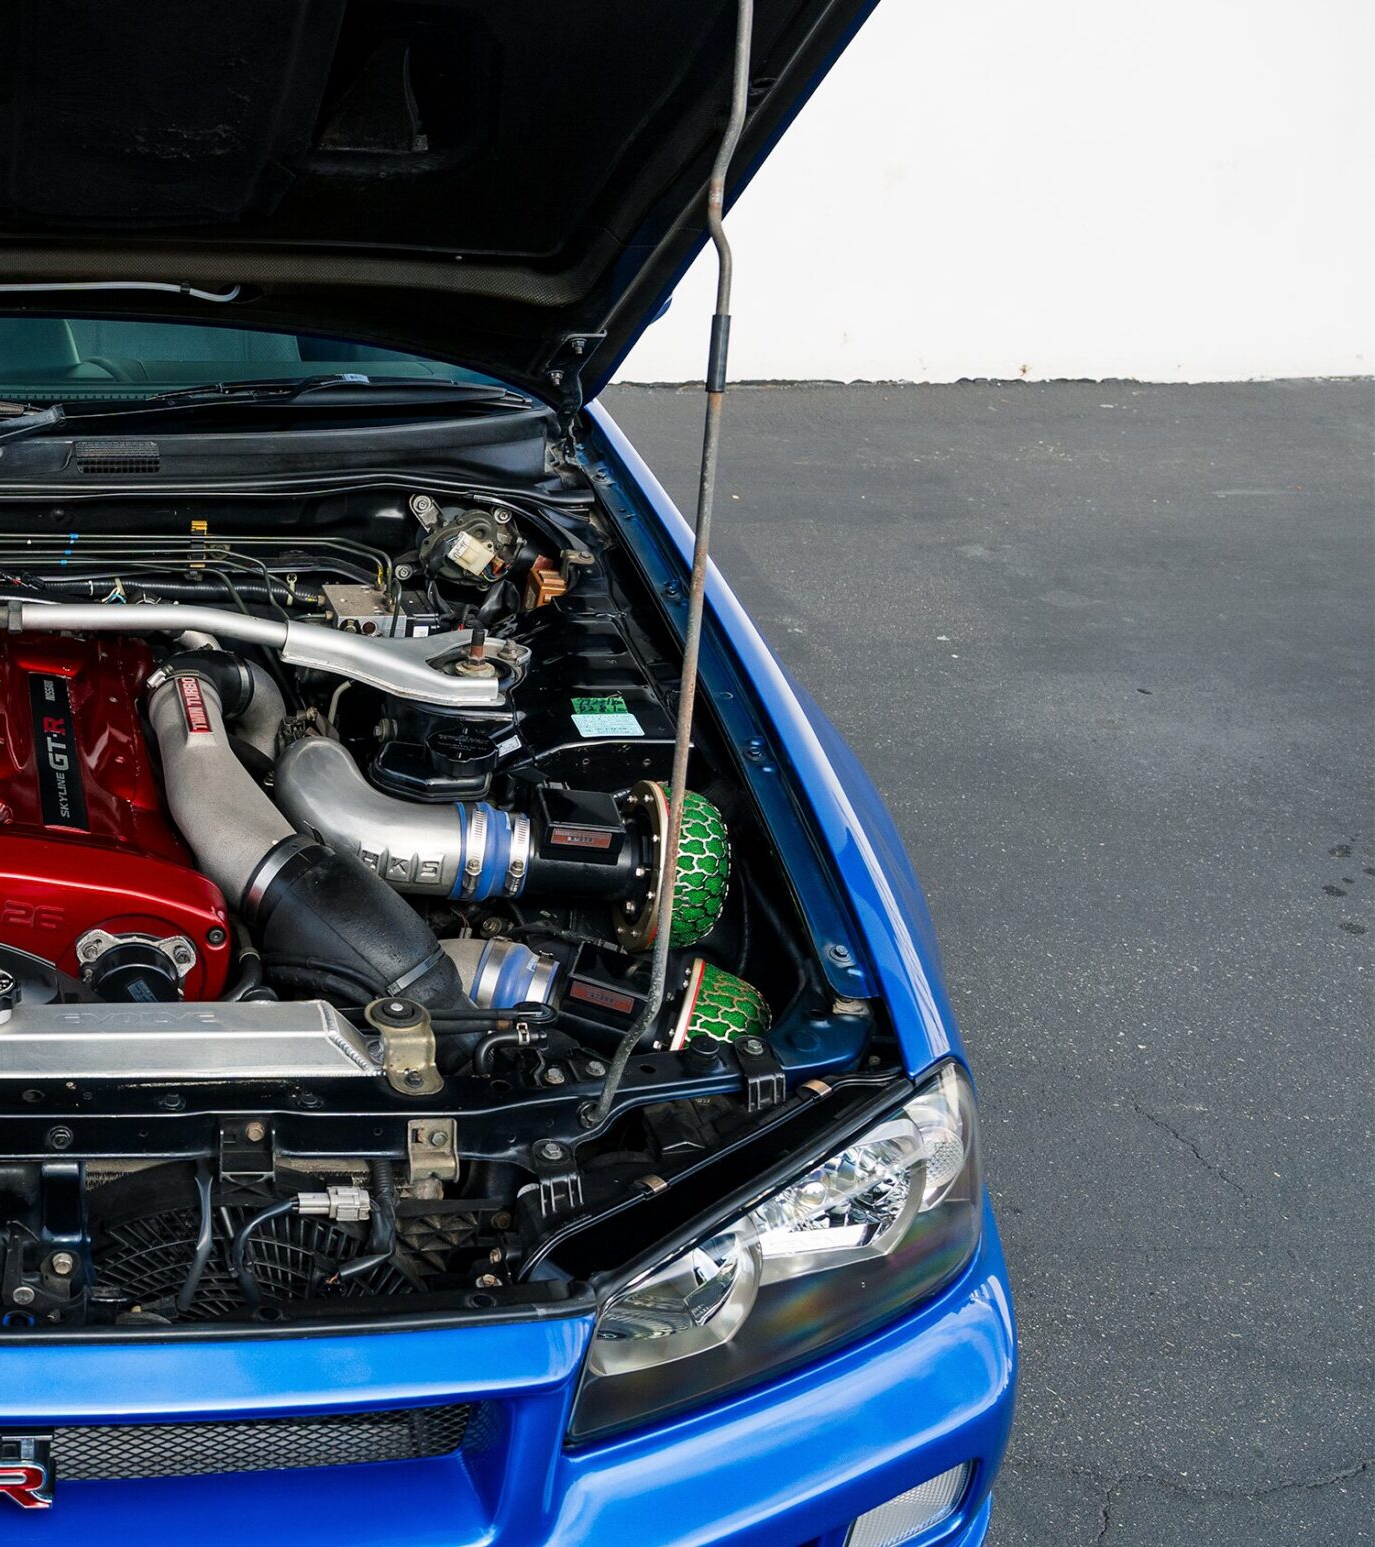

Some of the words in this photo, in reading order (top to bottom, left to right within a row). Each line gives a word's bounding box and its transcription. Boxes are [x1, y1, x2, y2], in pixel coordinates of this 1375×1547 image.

[181, 677, 203, 706] TURBO
[188, 706, 208, 730] TWIN
[56, 772, 71, 818] SKYLINE
